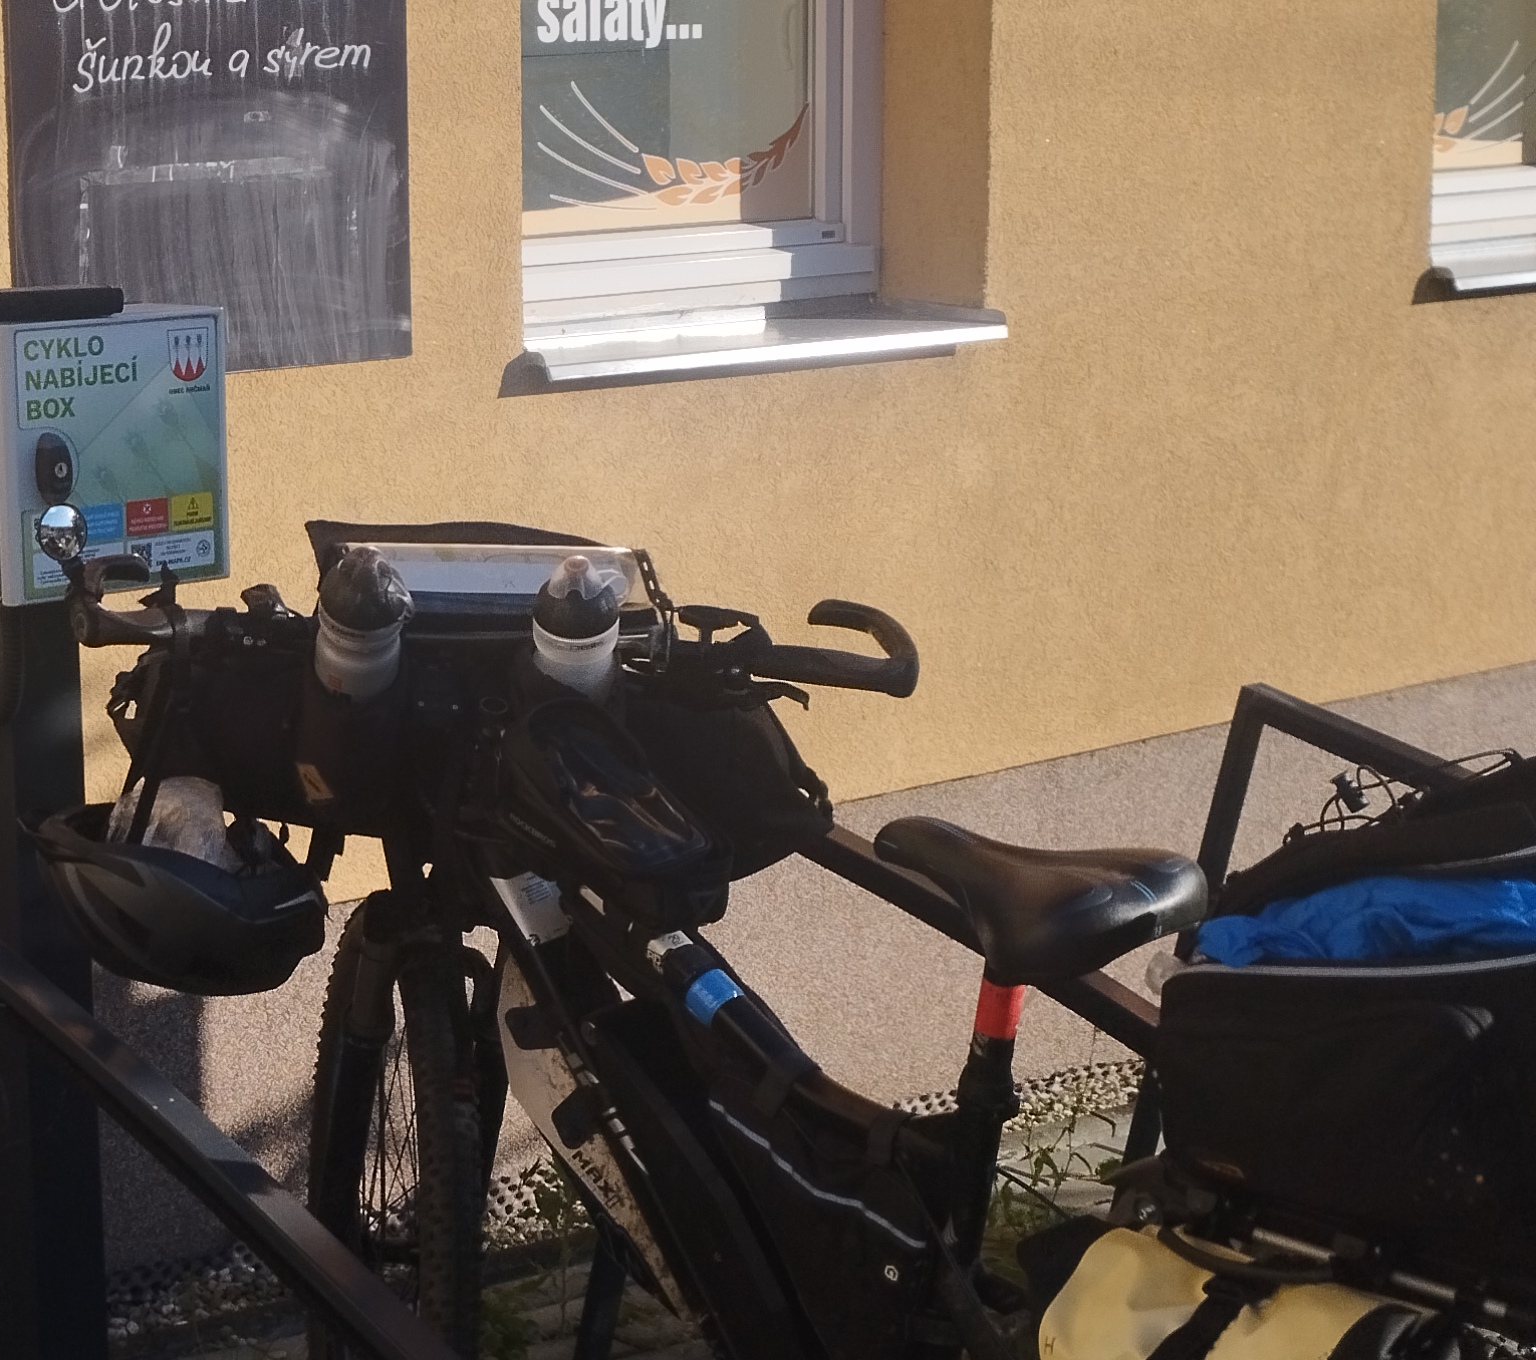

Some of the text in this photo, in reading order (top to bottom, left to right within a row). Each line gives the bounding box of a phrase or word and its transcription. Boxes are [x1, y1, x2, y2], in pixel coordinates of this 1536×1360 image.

[228, 47, 251, 80] a
[22, 334, 105, 362] CYKLO
[24, 354, 139, 392] NABÍJECÍ
[25, 396, 76, 421] BOX
